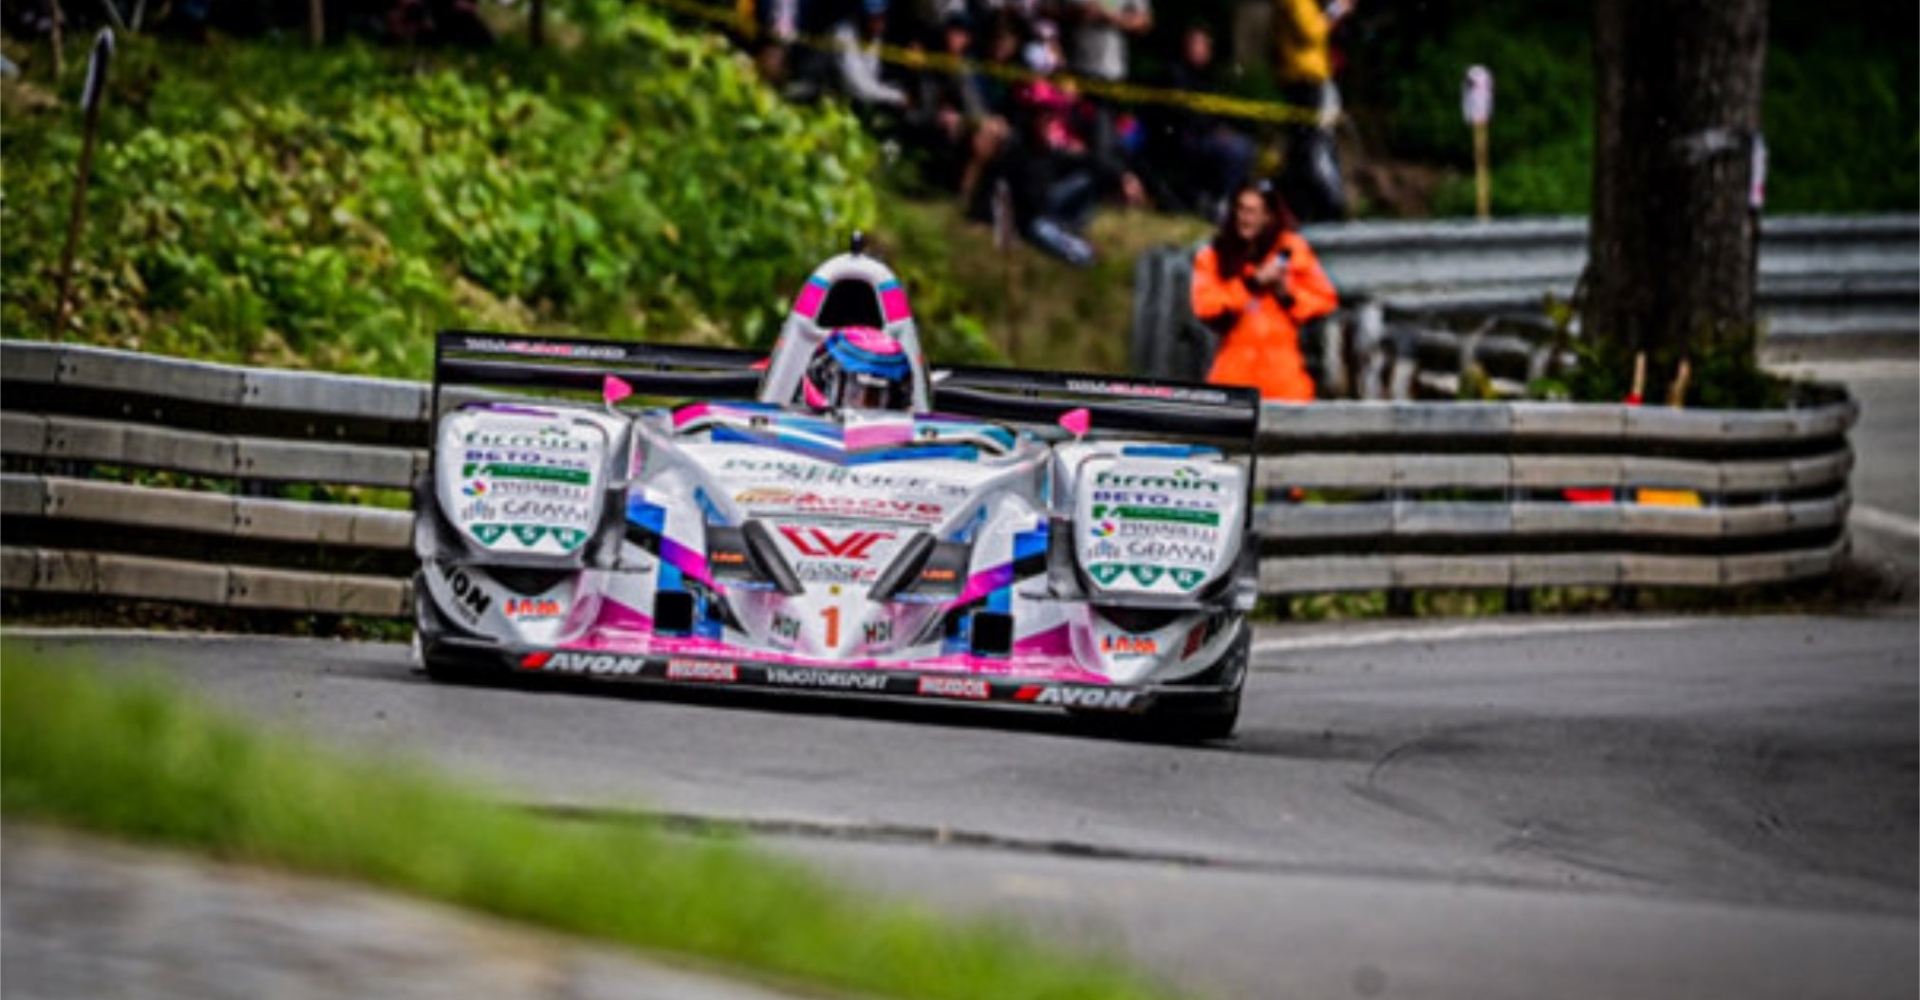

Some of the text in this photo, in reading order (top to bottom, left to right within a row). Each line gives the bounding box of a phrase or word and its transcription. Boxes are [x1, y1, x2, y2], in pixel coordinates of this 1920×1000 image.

[820, 606, 840, 648] 1
[545, 652, 646, 674] AVON
[1036, 687, 1136, 709] AVON
